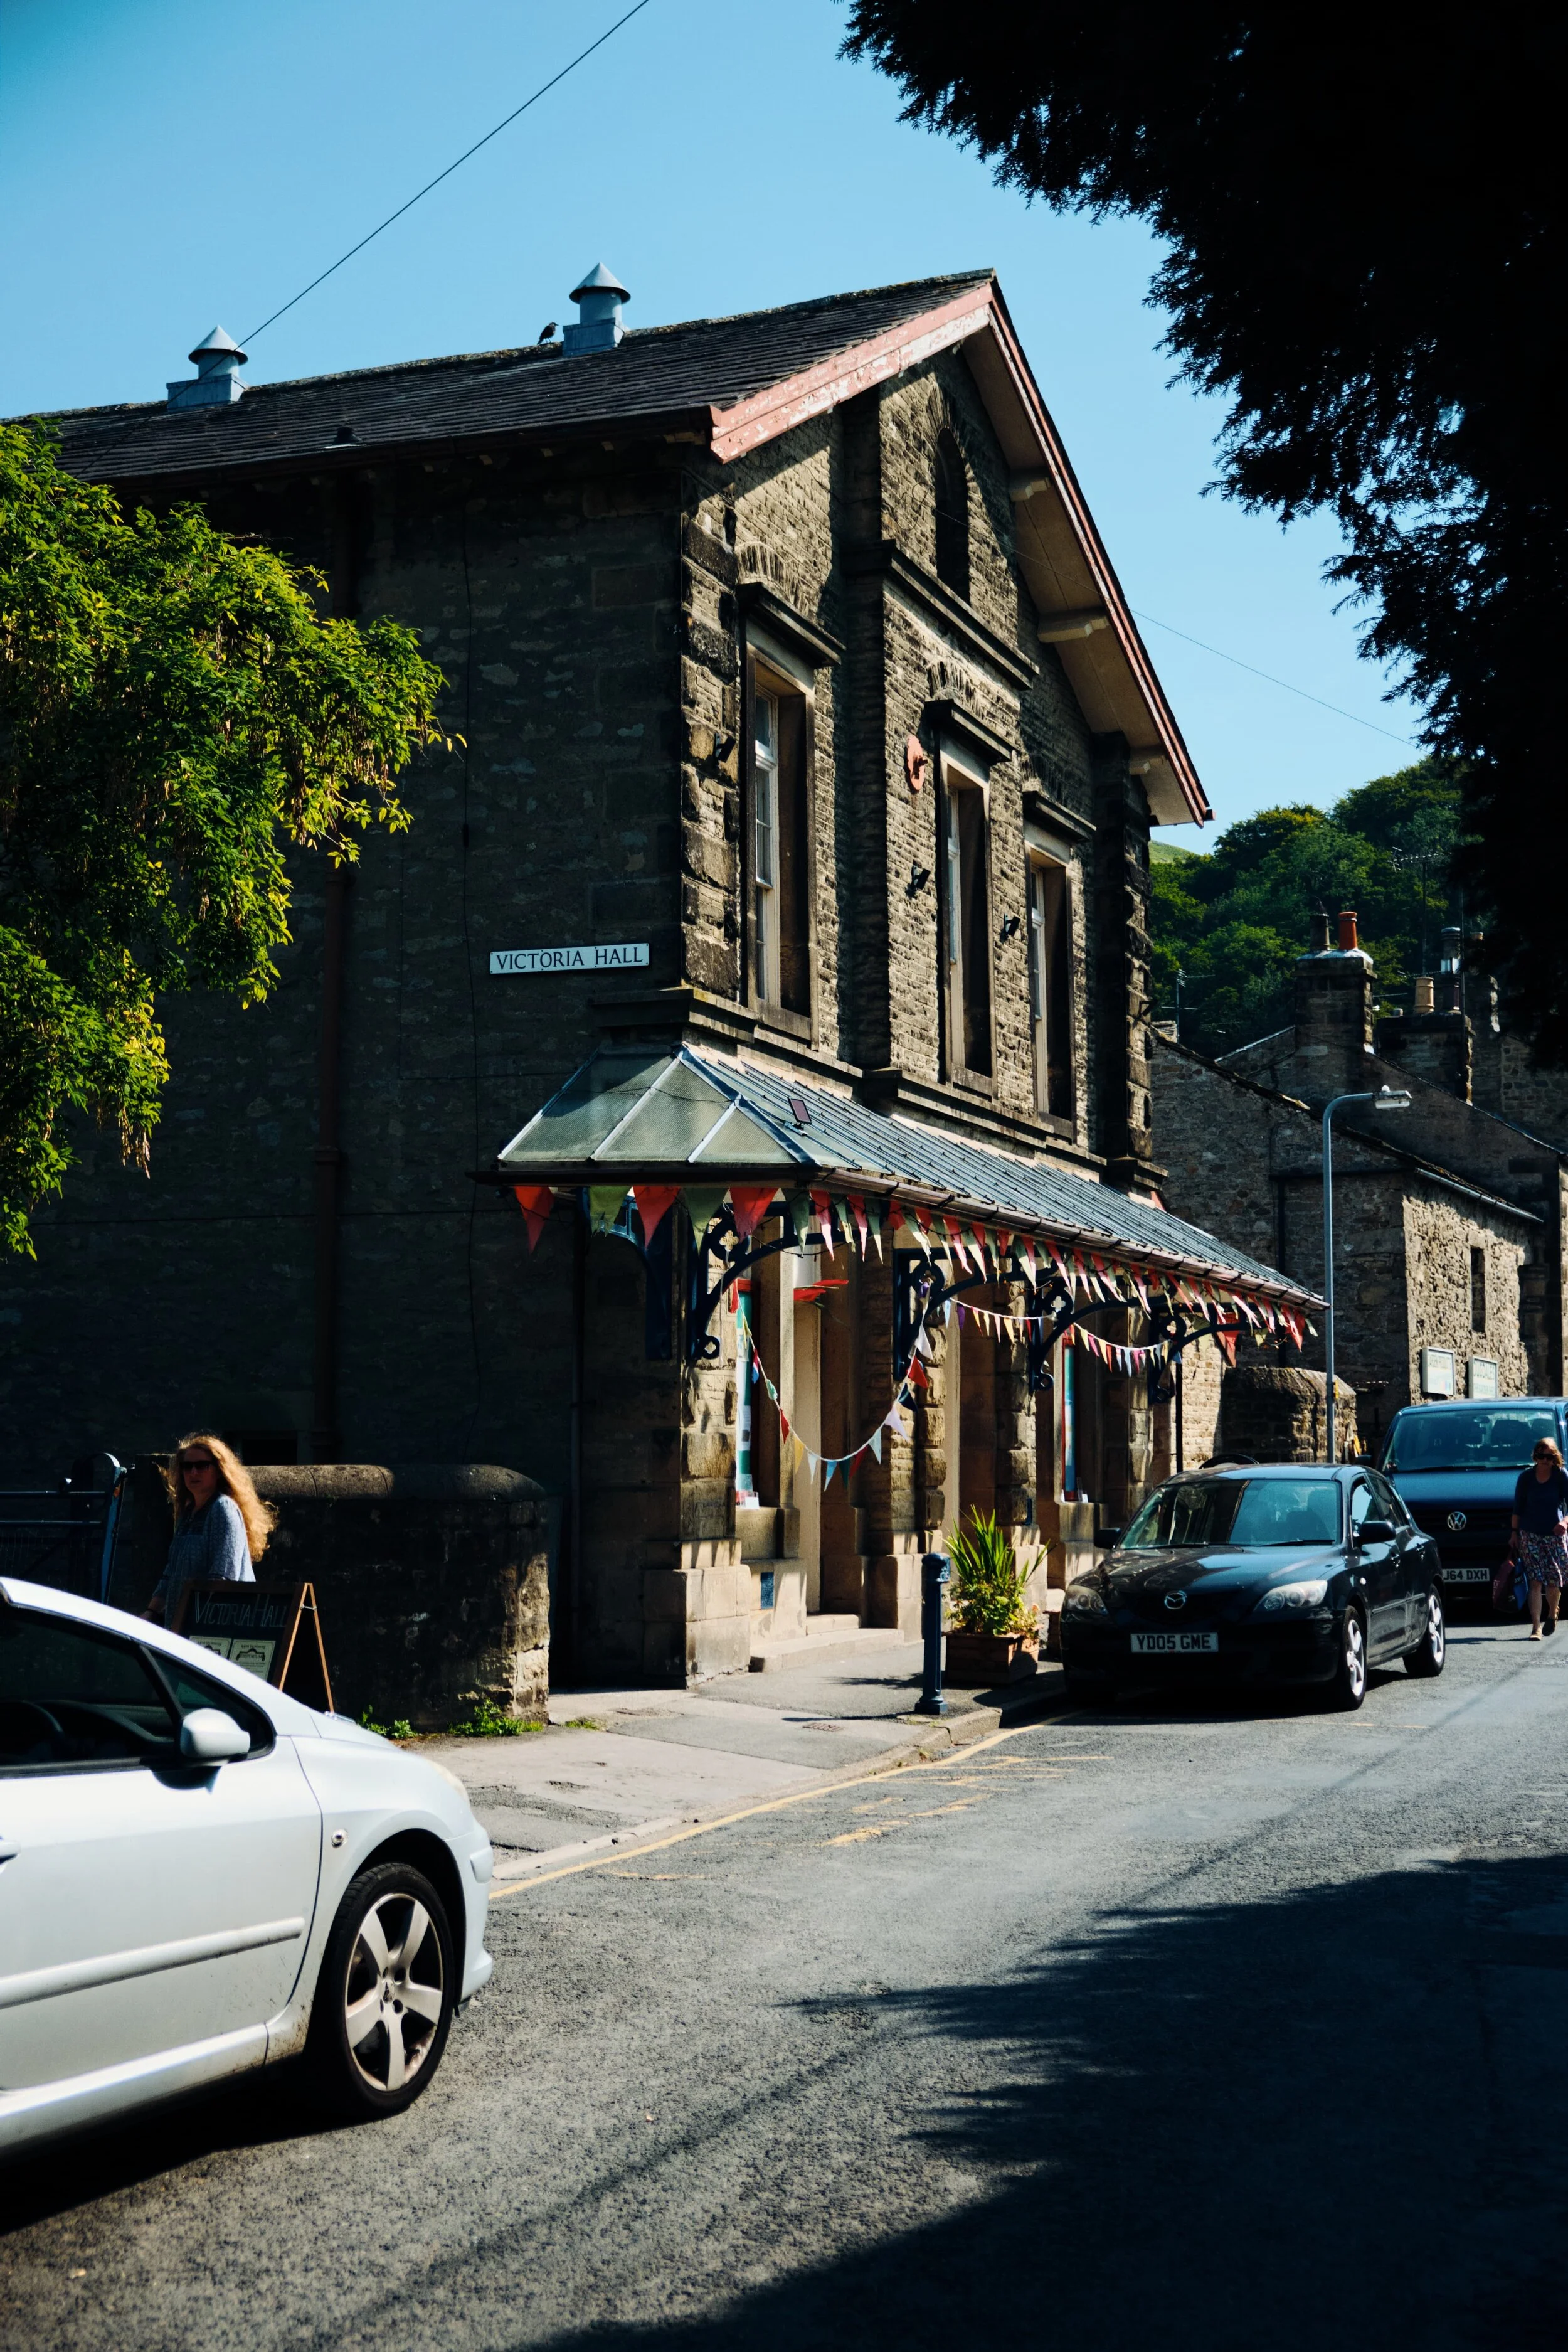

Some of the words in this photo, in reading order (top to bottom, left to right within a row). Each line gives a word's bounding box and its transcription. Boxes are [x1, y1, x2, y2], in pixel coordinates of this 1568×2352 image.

[496, 950, 585, 970] VICTORIA
[595, 947, 643, 965] HALL
[1443, 1570, 1463, 1580] J64
[1466, 1570, 1488, 1580] DXH
[1136, 1634, 1177, 1650] YD05
[1180, 1634, 1212, 1649] GME
